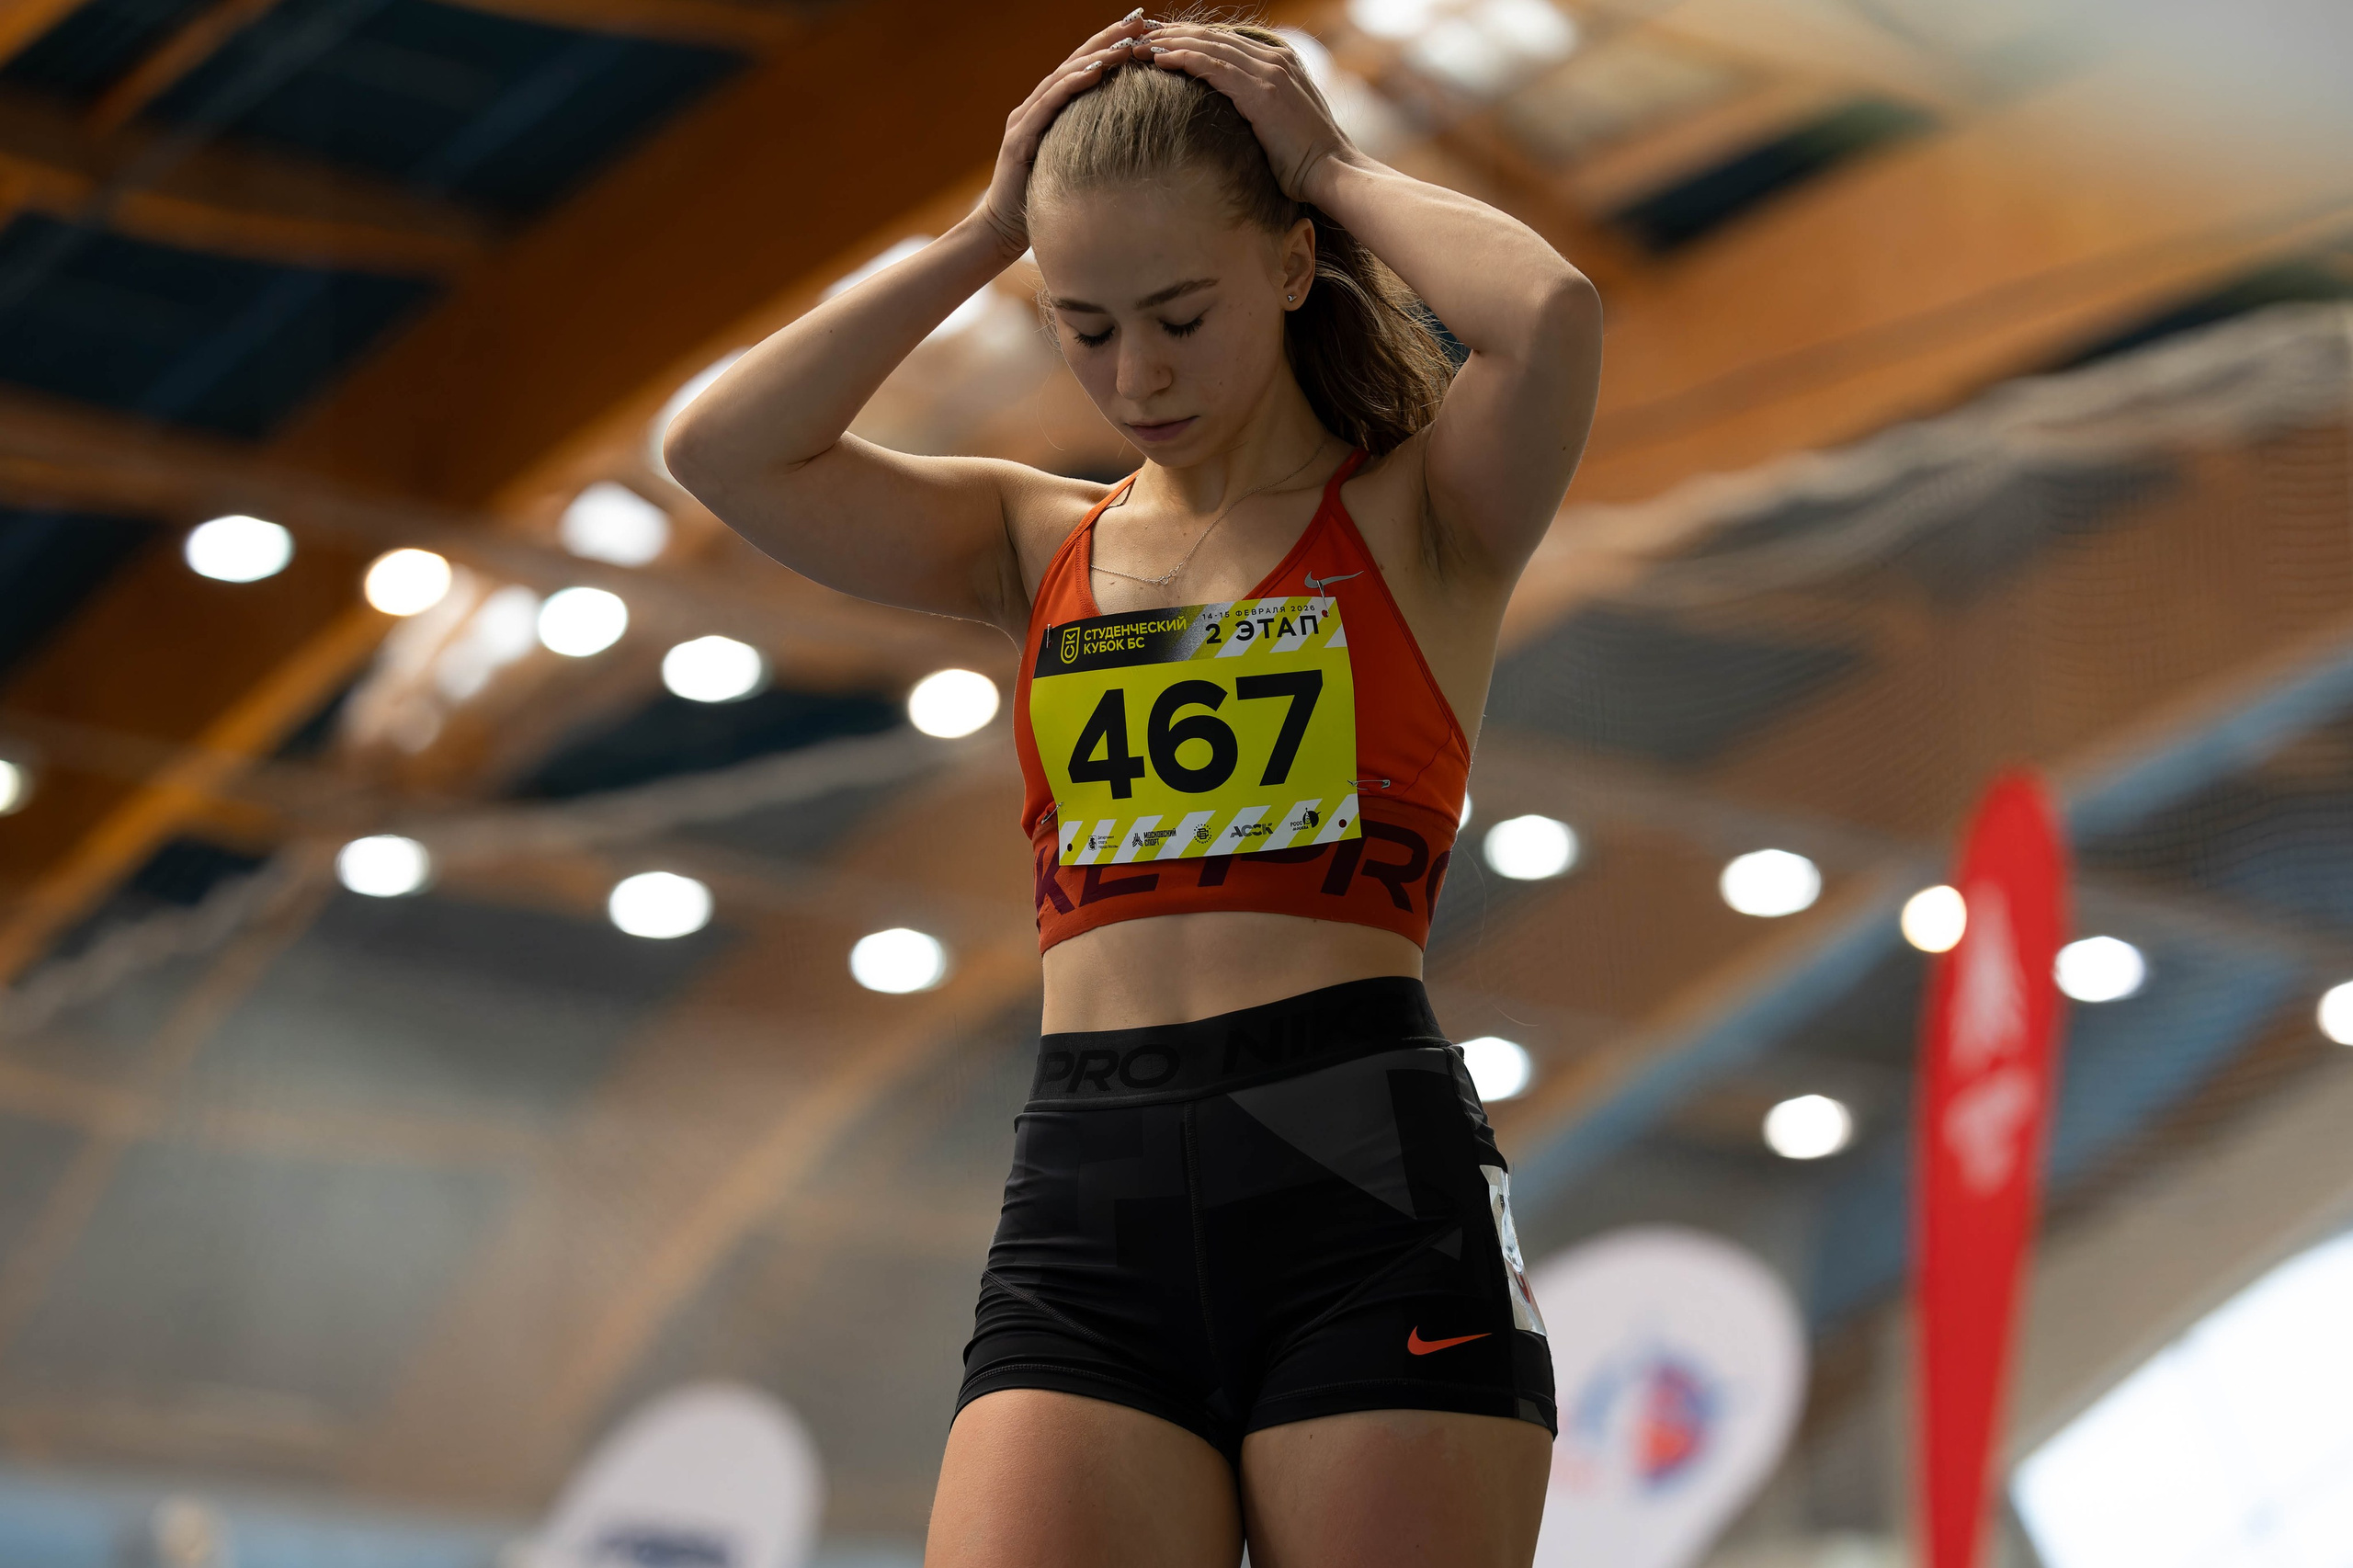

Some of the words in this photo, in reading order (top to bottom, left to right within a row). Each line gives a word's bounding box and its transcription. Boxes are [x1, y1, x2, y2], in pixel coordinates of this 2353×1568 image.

[1202, 610, 1230, 620] 14-15
[1234, 606, 1286, 617] ФЕВРАЛЯ
[1084, 616, 1187, 642] СТУДЕНЧЕСКИЙ
[1205, 623, 1222, 645] 2
[1234, 615, 1320, 642] ЭТАП
[1083, 639, 1125, 655] КУБОК
[1127, 636, 1145, 650] БС
[1067, 669, 1324, 800] 467
[1142, 827, 1177, 839] МОСКОВСКИЙ
[1143, 837, 1160, 846] СПОРТ
[1036, 1043, 1182, 1096] PRO
